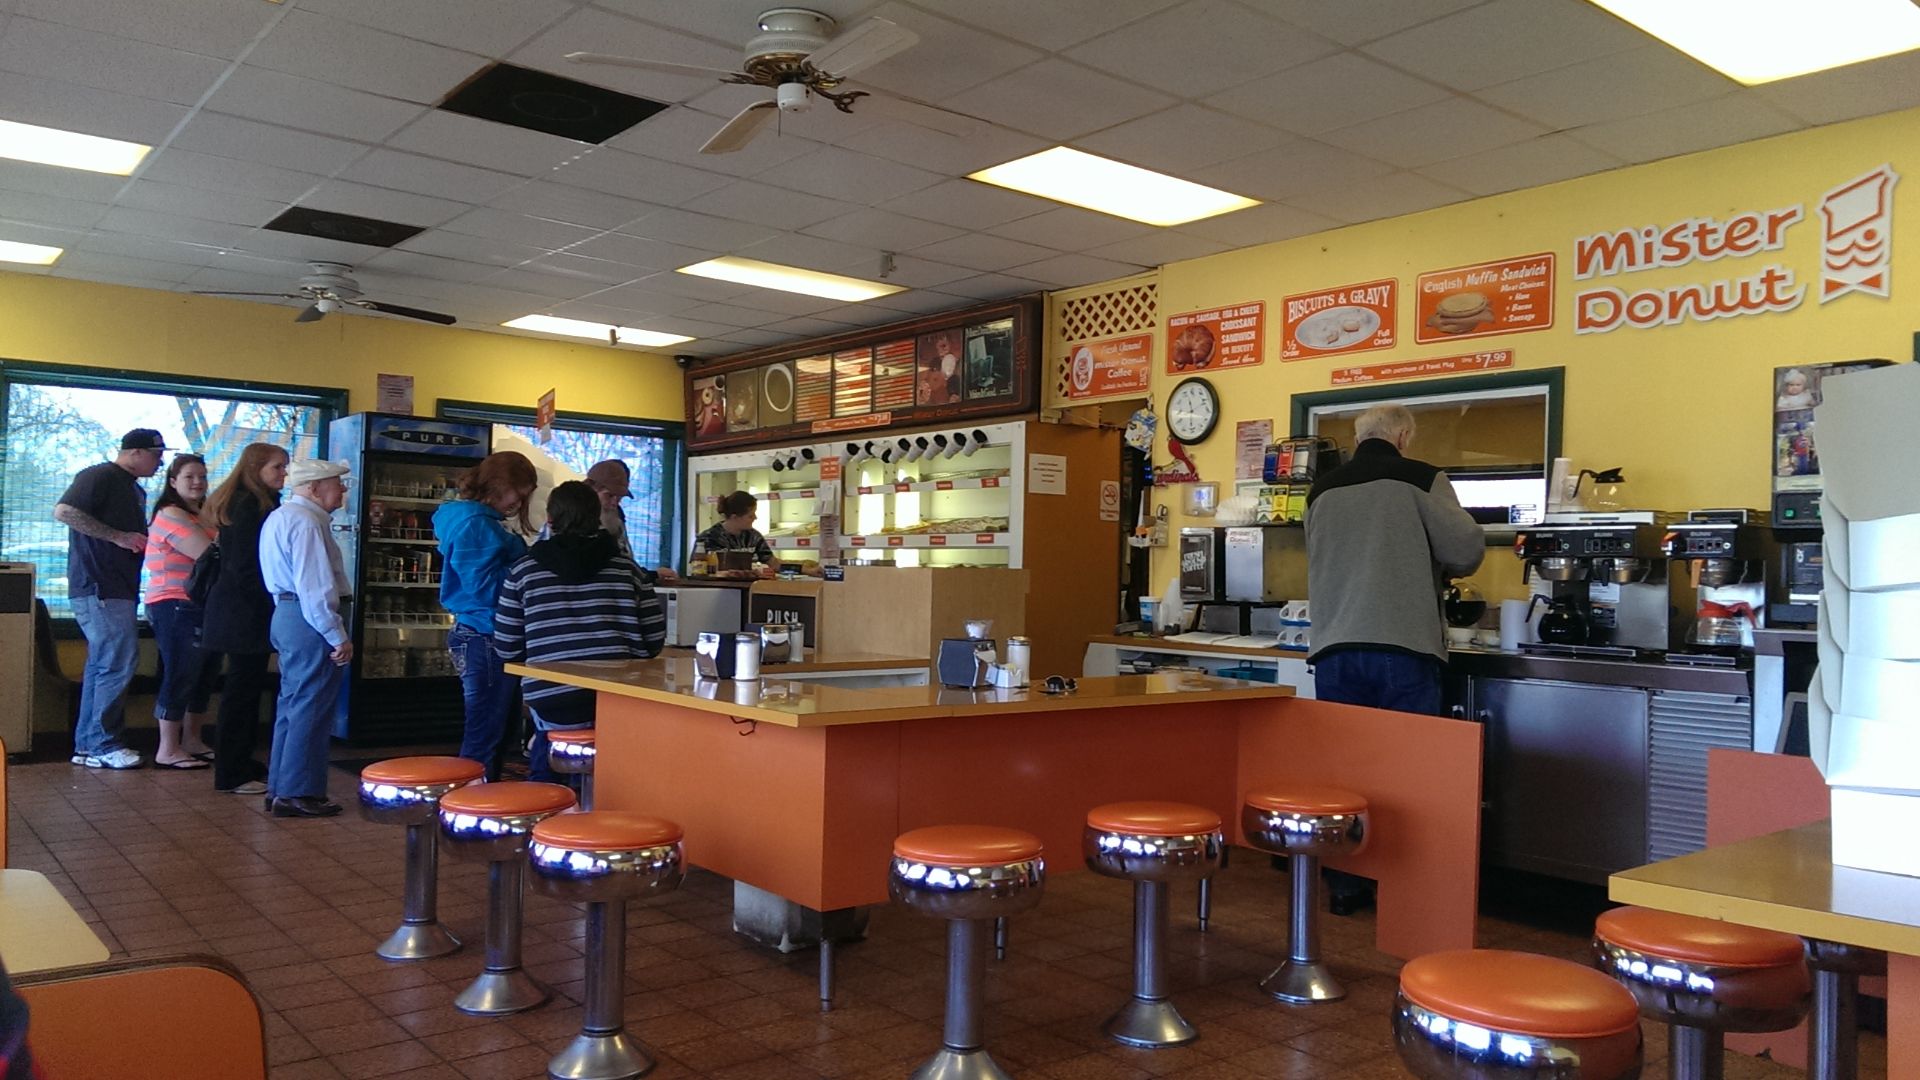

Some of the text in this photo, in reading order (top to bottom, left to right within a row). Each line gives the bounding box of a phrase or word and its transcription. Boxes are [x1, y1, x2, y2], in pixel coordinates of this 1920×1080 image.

[1575, 206, 1800, 278] Mister
[1424, 262, 1547, 293] English Muffin Sandwich
[1514, 293, 1530, 301] Ham
[1575, 267, 1803, 332] Donut
[1288, 285, 1391, 324] BISCUITS & GRAVY
[1511, 303, 1532, 312] Bacon
[1221, 316, 1257, 331] CROISSANT
[1507, 313, 1536, 323] Sausage
[1221, 331, 1256, 344] SANDWICH
[1377, 328, 1391, 337] Full
[1373, 337, 1394, 346] Order
[1231, 343, 1254, 354] BISCUIT
[1282, 350, 1300, 358] Order
[1121, 355, 1147, 365] Donut
[1475, 352, 1507, 368] $7.99
[1107, 368, 1132, 379] Coffee
[402, 432, 461, 445] PURE
[767, 609, 798, 624] PUSH
